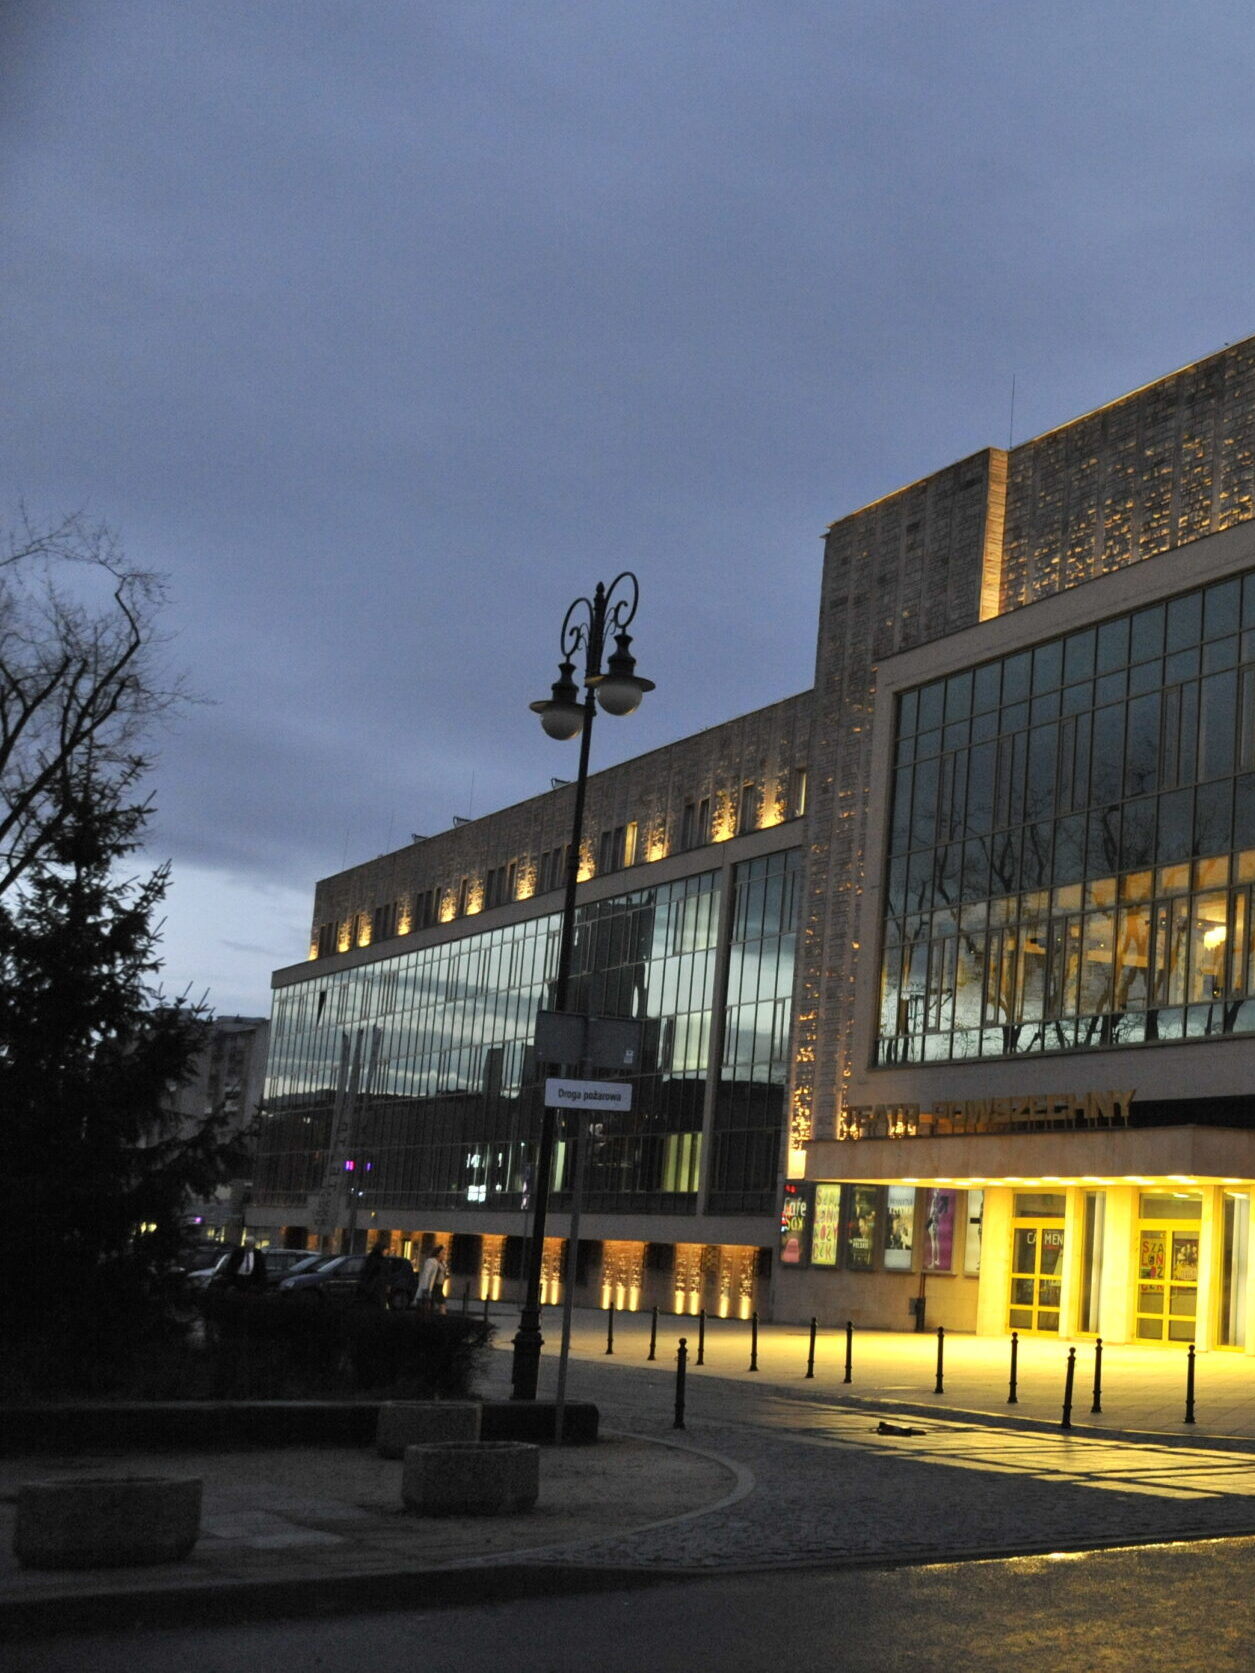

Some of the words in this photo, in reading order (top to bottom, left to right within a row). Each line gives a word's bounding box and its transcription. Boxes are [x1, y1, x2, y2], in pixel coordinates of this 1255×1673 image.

[558, 1088, 582, 1101] Droga
[583, 1090, 622, 1102] pożarowa
[932, 1088, 1135, 1125] POWSZECHNY
[1027, 1232, 1063, 1246] CAMEN
